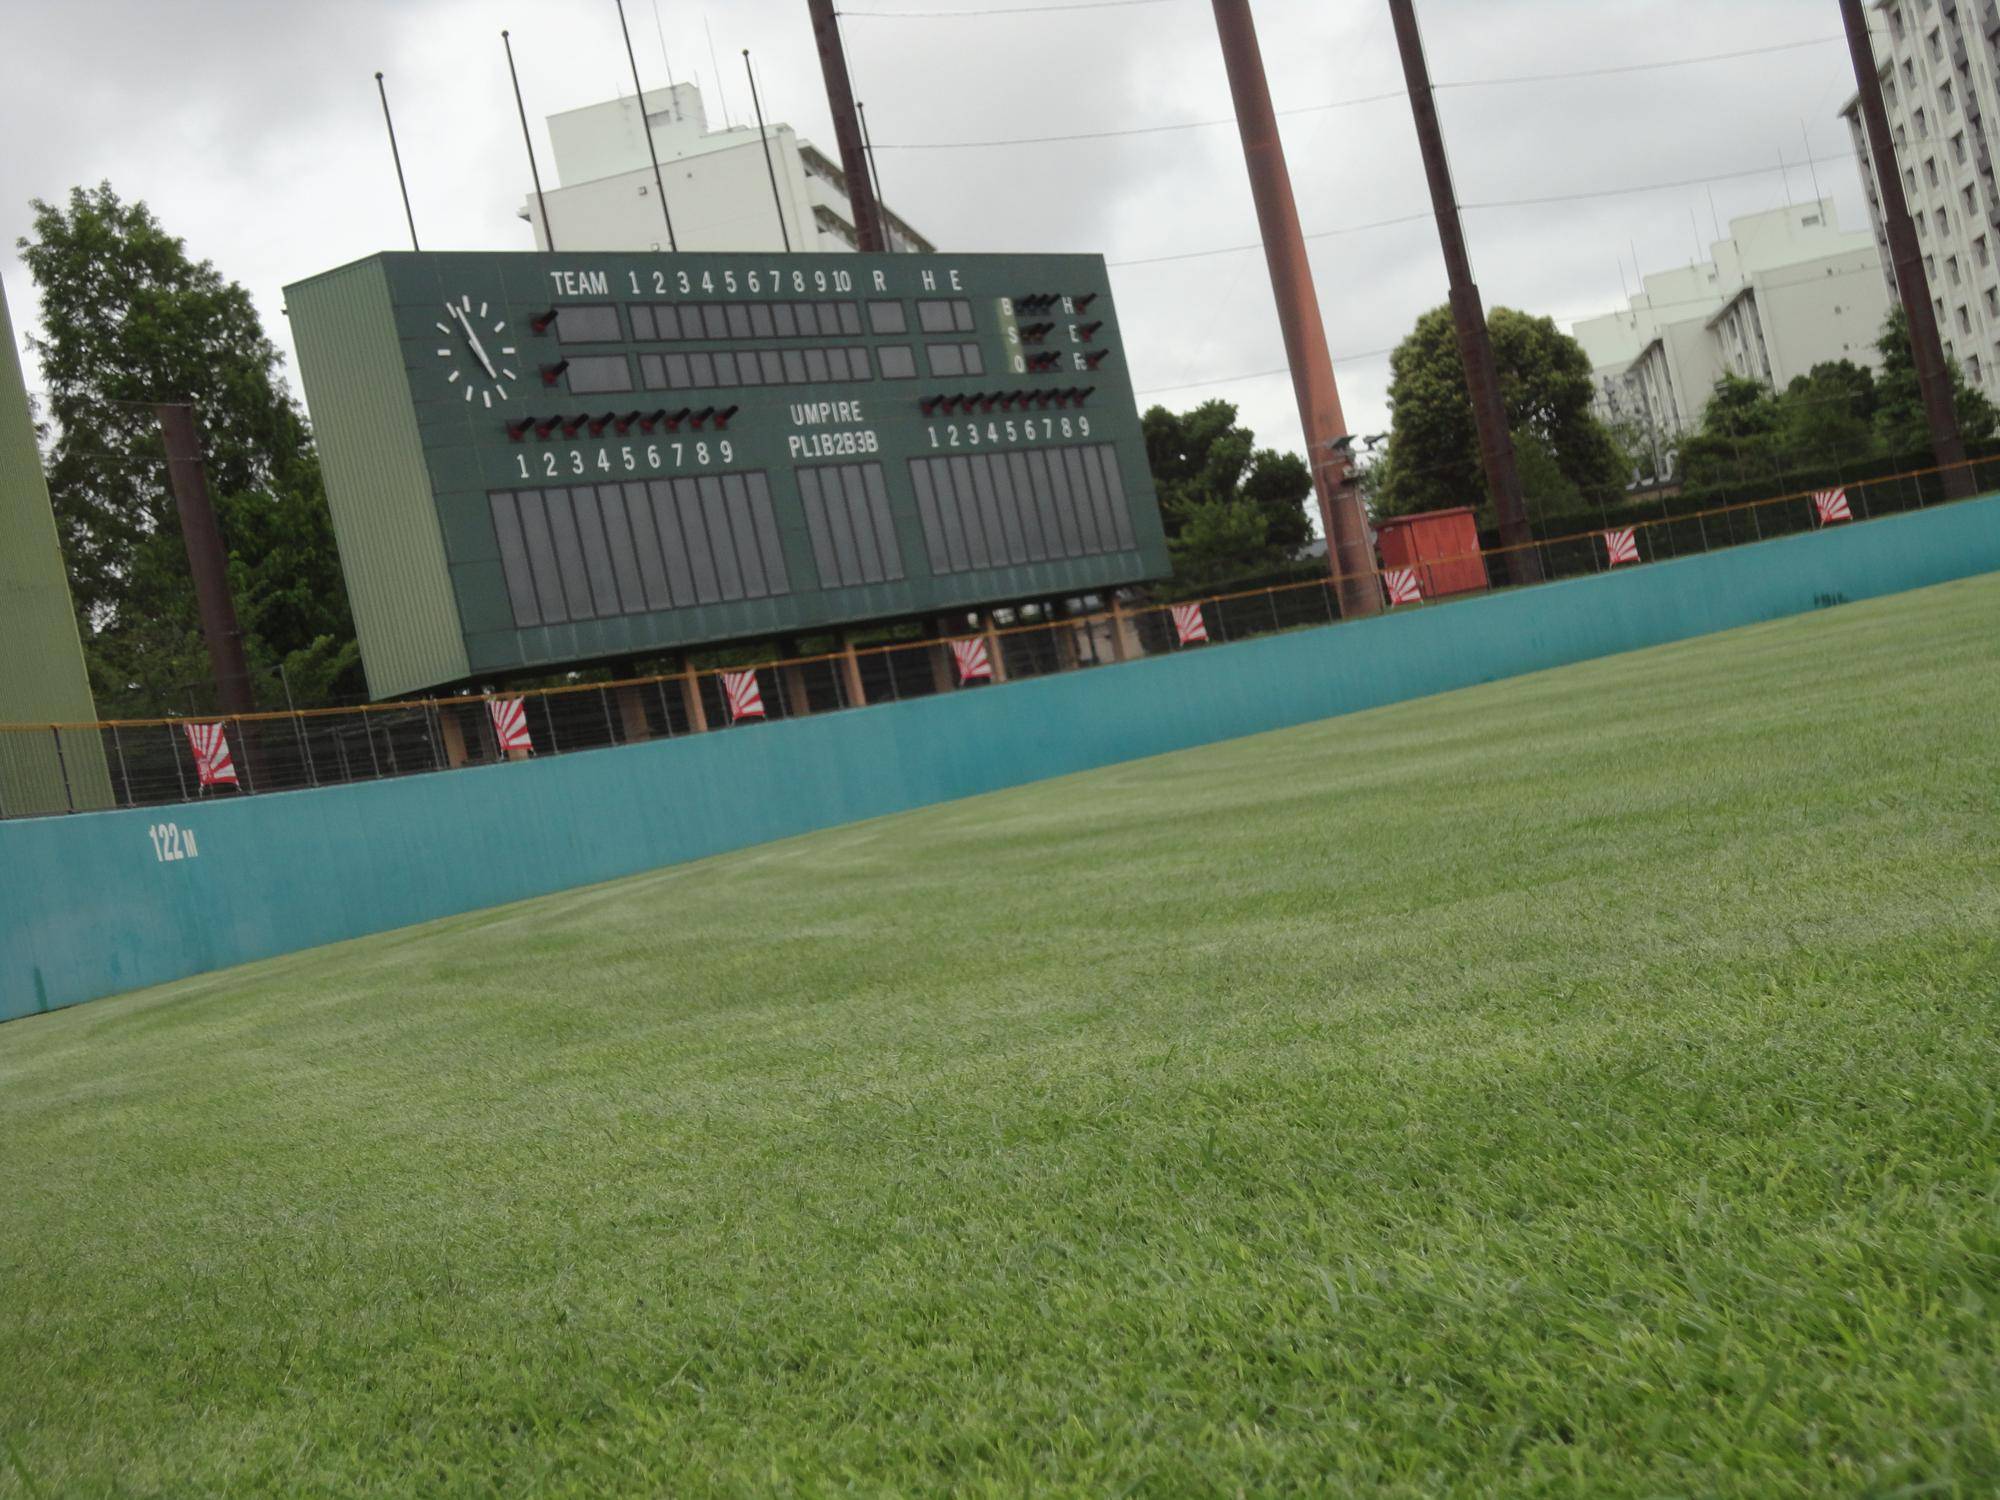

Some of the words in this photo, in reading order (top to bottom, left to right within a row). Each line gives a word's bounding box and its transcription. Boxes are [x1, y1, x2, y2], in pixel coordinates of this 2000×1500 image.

[549, 270, 609, 296] TEAM
[628, 270, 641, 295] 1
[652, 270, 667, 295] 2
[676, 270, 691, 294] 3
[701, 270, 715, 294] 4
[724, 270, 737, 294] 5
[747, 270, 761, 293] 6
[769, 270, 780, 293] 7
[792, 270, 805, 293] 8
[814, 270, 827, 293] 9
[831, 270, 852, 293] 10
[872, 269, 887, 291] R
[921, 270, 937, 291] H
[949, 269, 963, 291] E
[1062, 296, 1075, 314] H
[1007, 326, 1019, 344] S
[790, 400, 864, 426] UMPIRE
[927, 426, 939, 448] 1
[947, 424, 960, 447] 2
[967, 423, 980, 445] 3
[987, 422, 999, 443] 4
[1005, 420, 1017, 442] 5
[1024, 419, 1036, 441] 6
[1042, 418, 1052, 439] 7
[1060, 417, 1073, 438] 8
[1078, 415, 1090, 437] 9
[516, 453, 530, 479] 1
[543, 452, 558, 477] 2
[569, 450, 585, 475] 3
[597, 447, 611, 473] 4
[621, 446, 636, 471] 5
[647, 444, 661, 469] 6
[671, 442, 683, 467] 7
[695, 441, 710, 465] 8
[719, 439, 733, 464] 9
